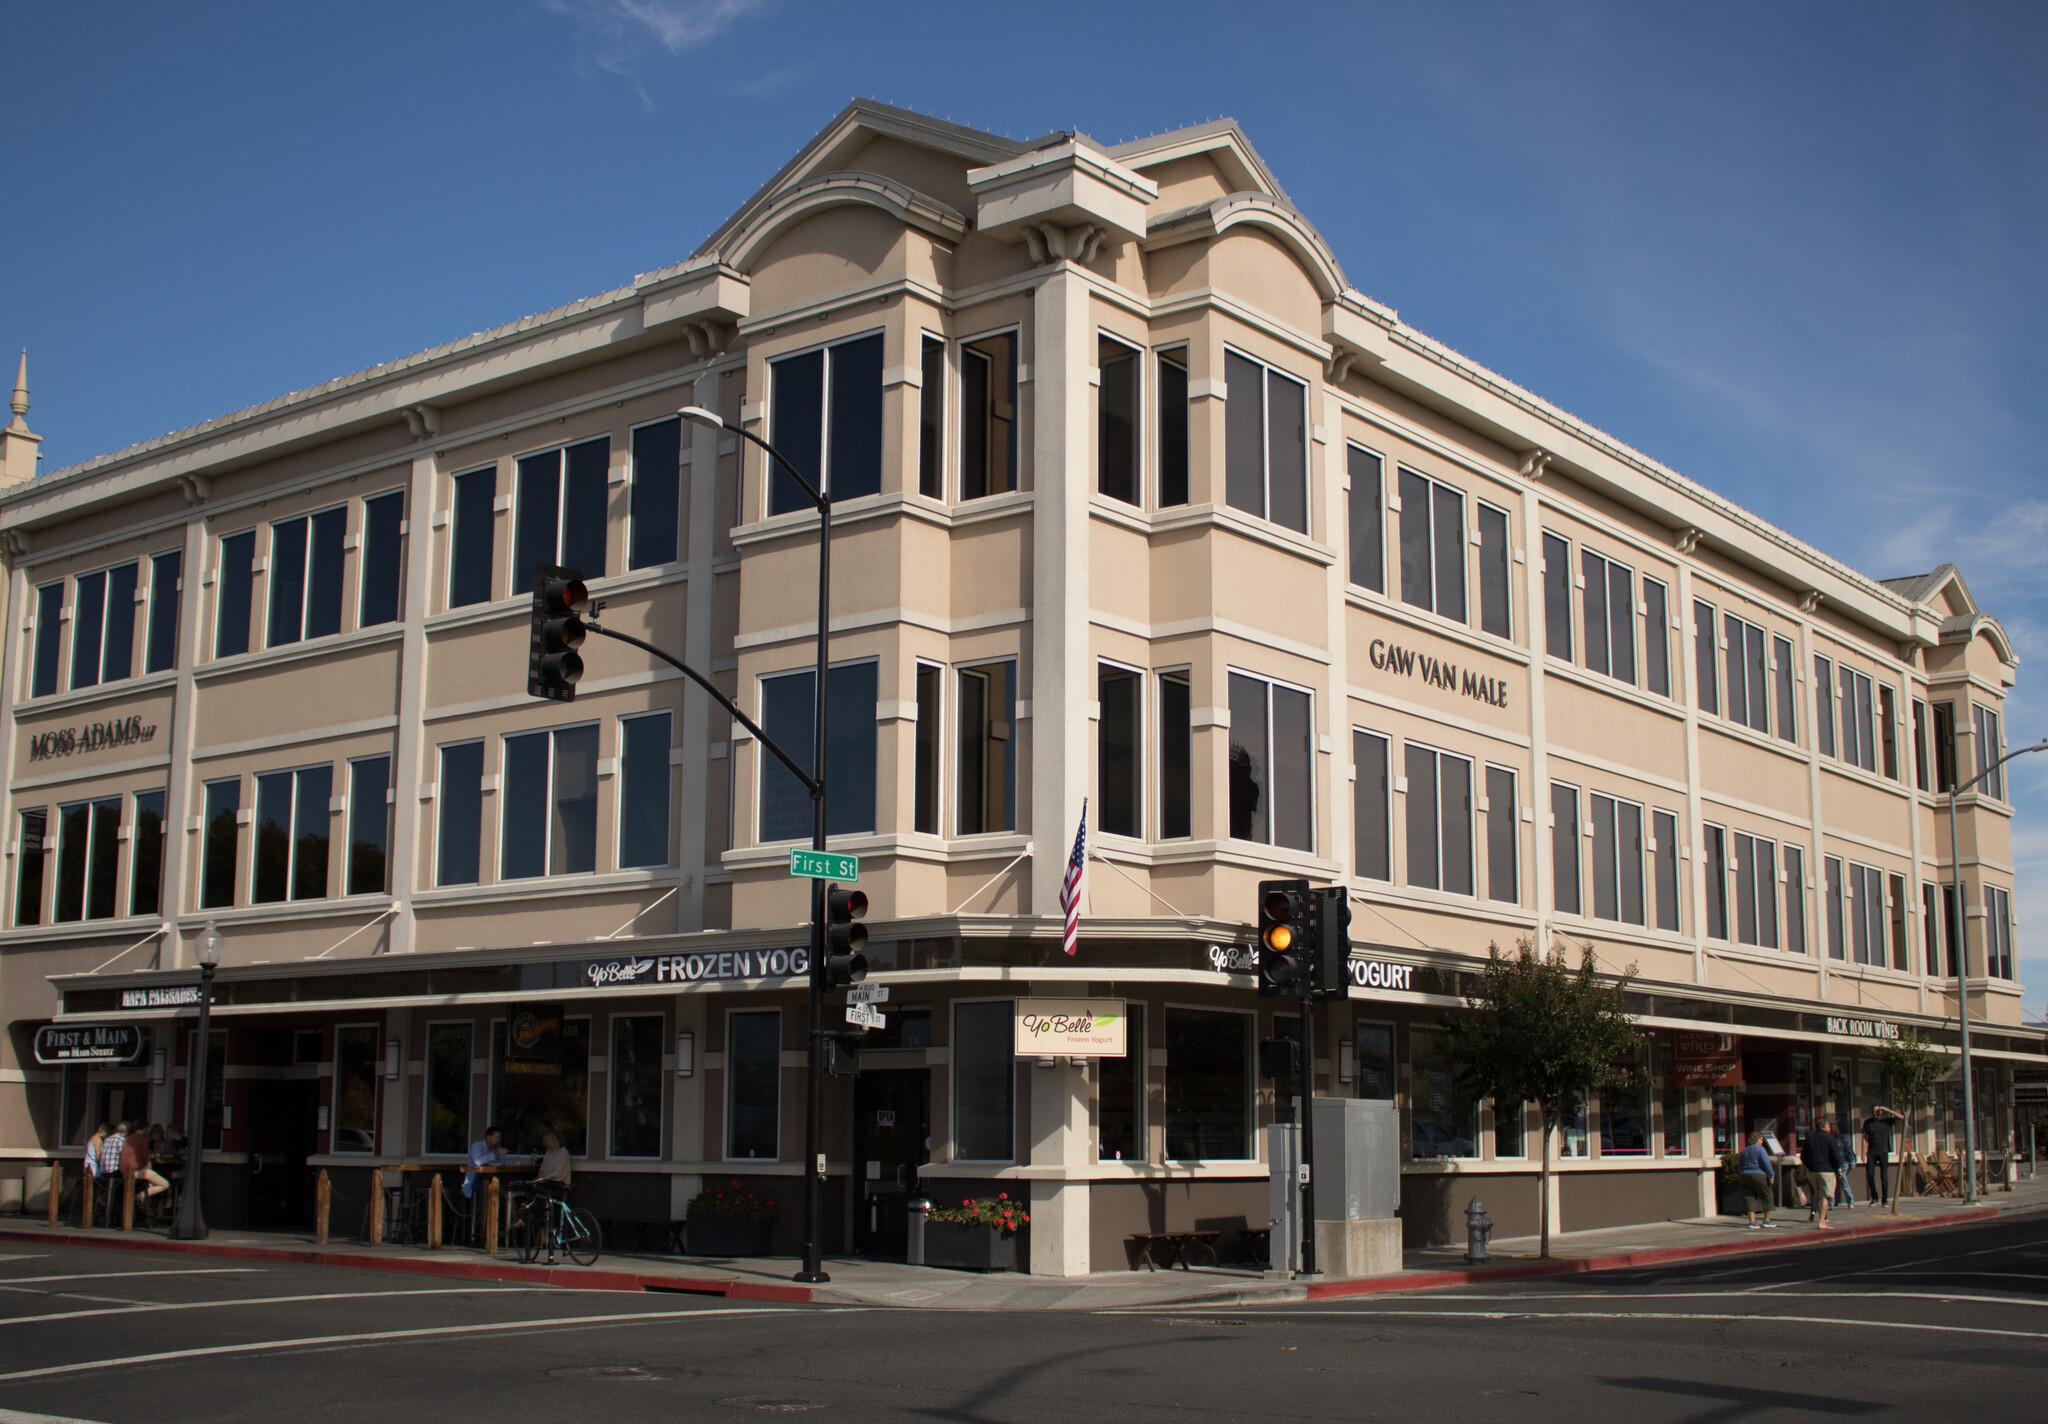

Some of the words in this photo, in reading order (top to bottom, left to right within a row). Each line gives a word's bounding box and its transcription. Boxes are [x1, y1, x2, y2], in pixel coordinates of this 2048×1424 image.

[1369, 639, 1415, 678] GAW
[1418, 653, 1457, 692] VAN
[1461, 668, 1507, 709] MALE
[30, 728, 76, 761] MOSS
[80, 715, 141, 750] ADAMS
[793, 855, 830, 874] First
[840, 860, 854, 877] St
[657, 952, 750, 981] FROZEN
[756, 948, 808, 976] YOG
[122, 990, 147, 1007] NAPA
[852, 990, 870, 1002] MAIN
[877, 990, 884, 998] ST
[850, 1010, 869, 1023] FIRST
[875, 1015, 881, 1023] ST
[563, 1024, 578, 1037] EER
[1827, 1017, 1848, 1034] BACK
[1850, 1019, 1873, 1037] ROOM
[1874, 1020, 1899, 1039] WINES
[46, 1030, 81, 1047] FIRST
[83, 1031, 90, 1045] &
[95, 1028, 128, 1045] MAIN
[1091, 1036, 1112, 1044] Yogurt
[90, 1045, 115, 1057] STREET
[1680, 1040, 1715, 1054] WINES
[1676, 1064, 1704, 1072] WINE
[1705, 1063, 1736, 1072] SHOP
[878, 1111, 894, 1121] OPEN
